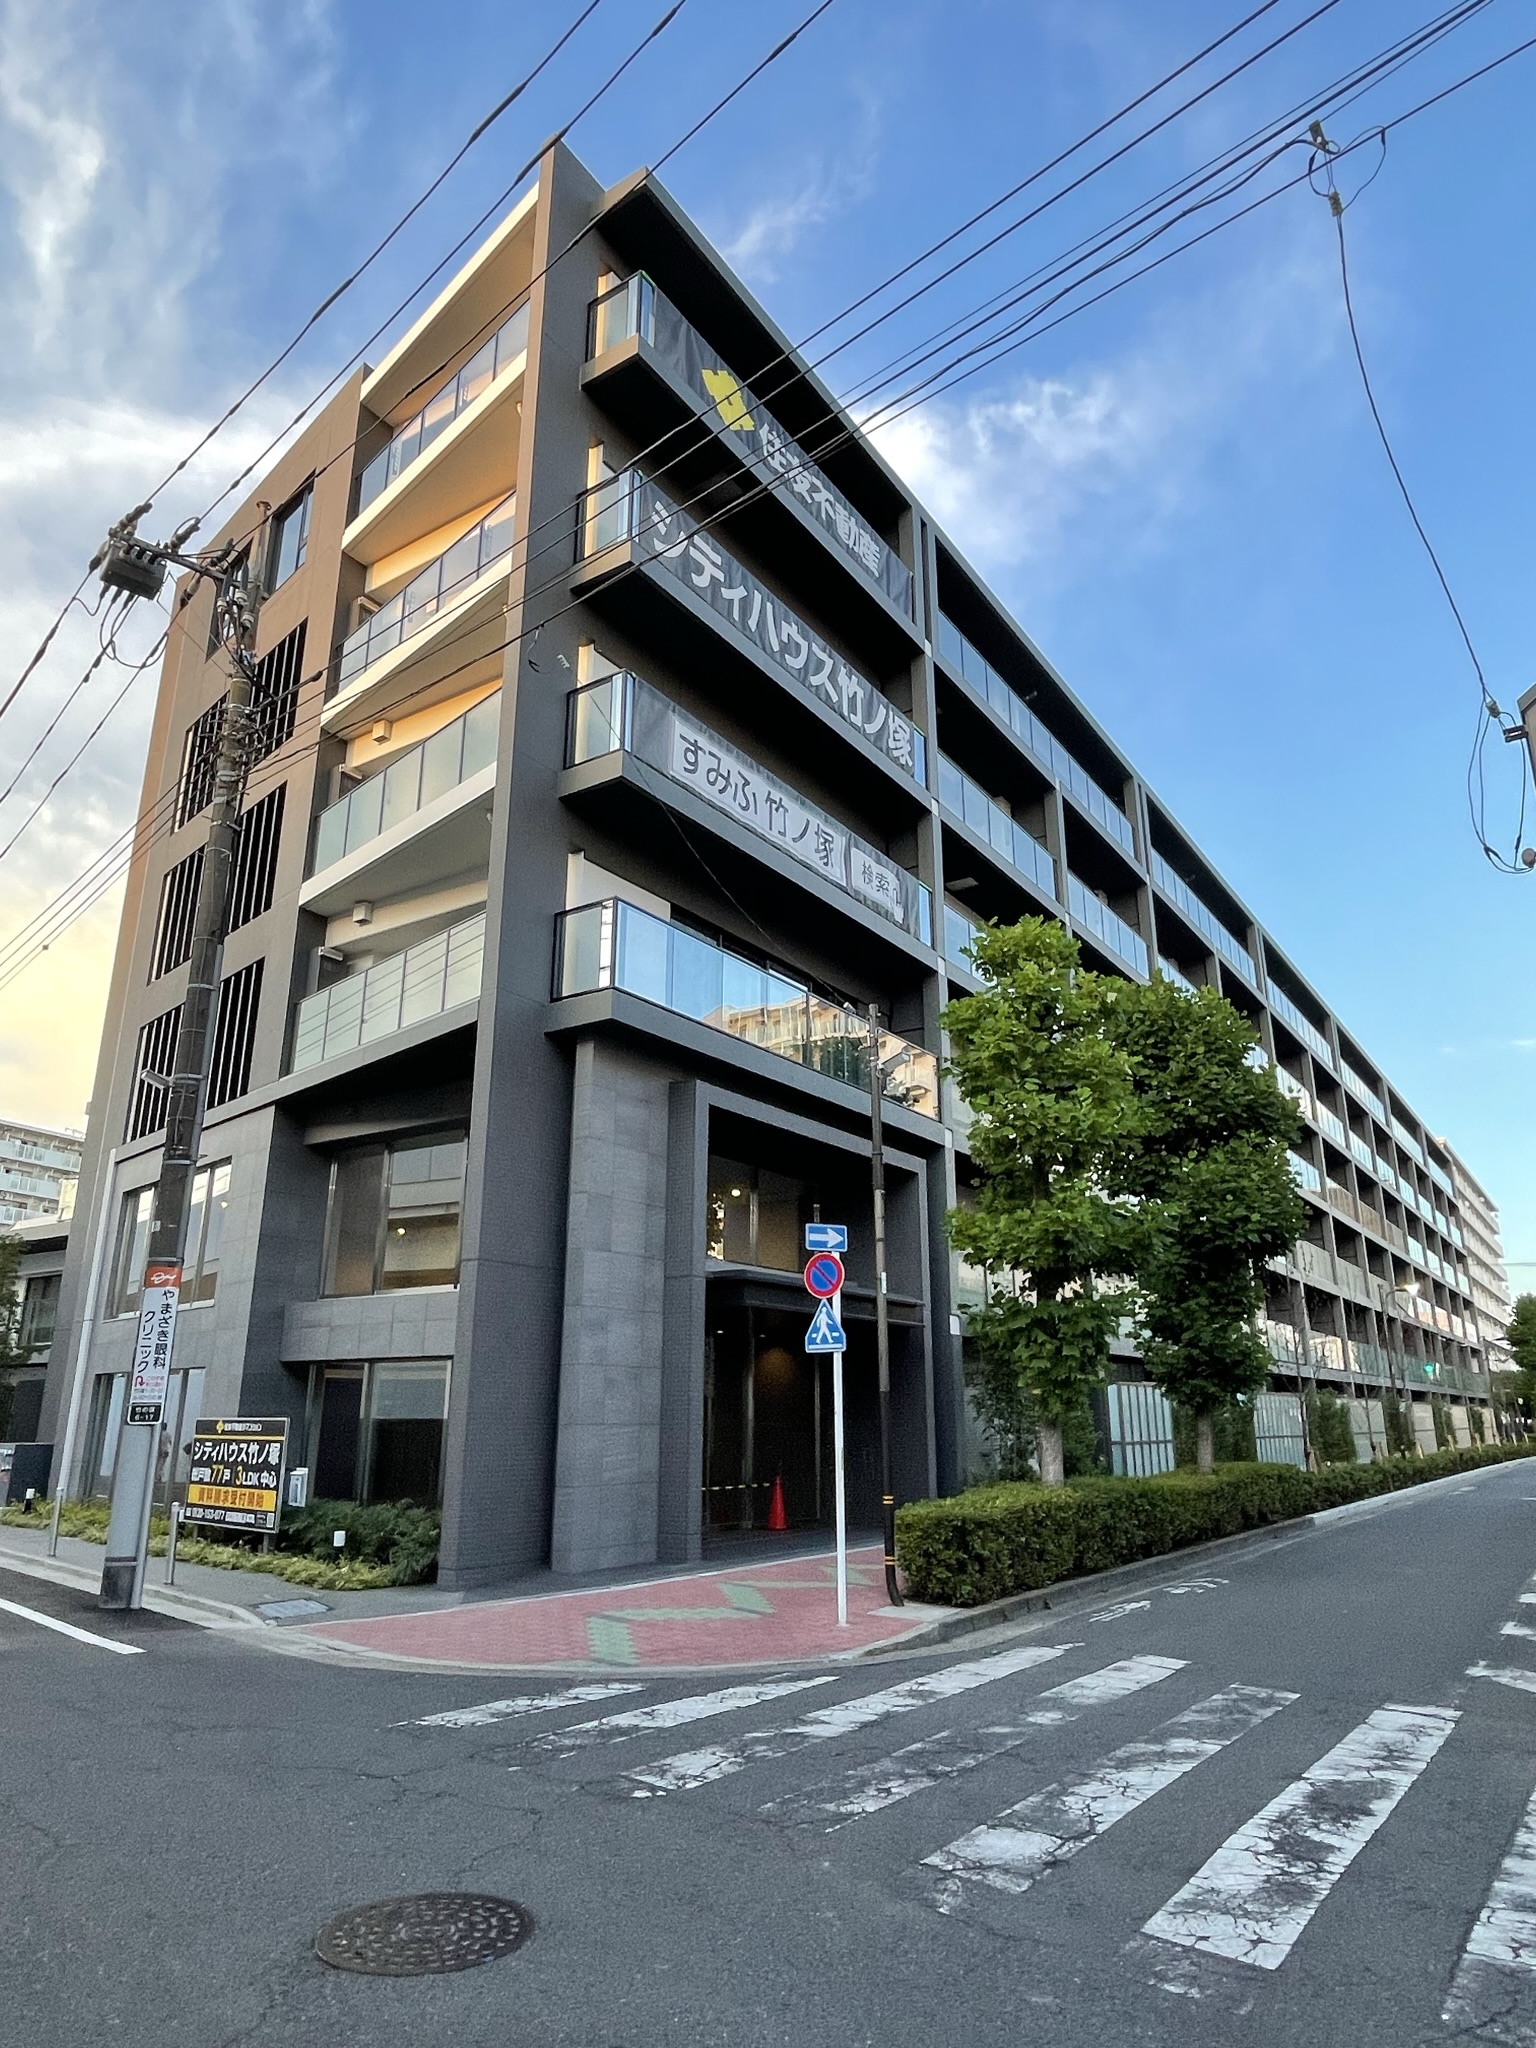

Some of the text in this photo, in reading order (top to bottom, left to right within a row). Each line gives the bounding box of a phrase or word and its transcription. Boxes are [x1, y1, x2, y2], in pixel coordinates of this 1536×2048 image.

[759, 423, 881, 577] 住友不動産
[651, 501, 913, 766] シティハウス竹ノ塚
[861, 860, 890, 898] 検索
[137, 1311, 155, 1373] クリニック
[152, 1289, 174, 1370] やまざき眼科
